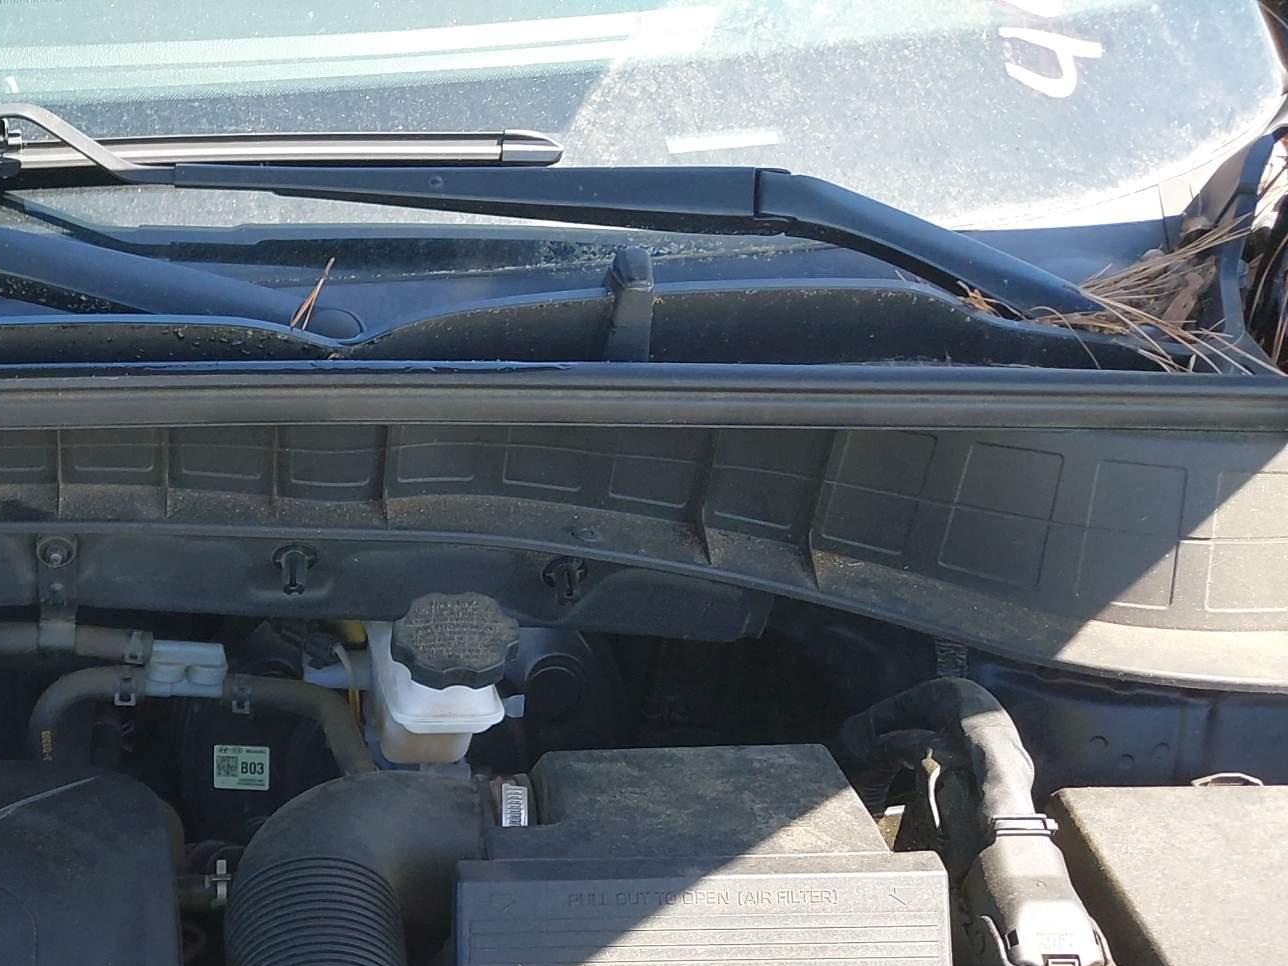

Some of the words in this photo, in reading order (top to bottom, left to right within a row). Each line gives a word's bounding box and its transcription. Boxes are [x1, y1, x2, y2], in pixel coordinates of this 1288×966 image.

[241, 761, 265, 775] B03
[567, 892, 608, 907] PULL
[615, 892, 650, 906] OUT
[655, 891, 678, 906] TO
[682, 890, 729, 905] OPEN
